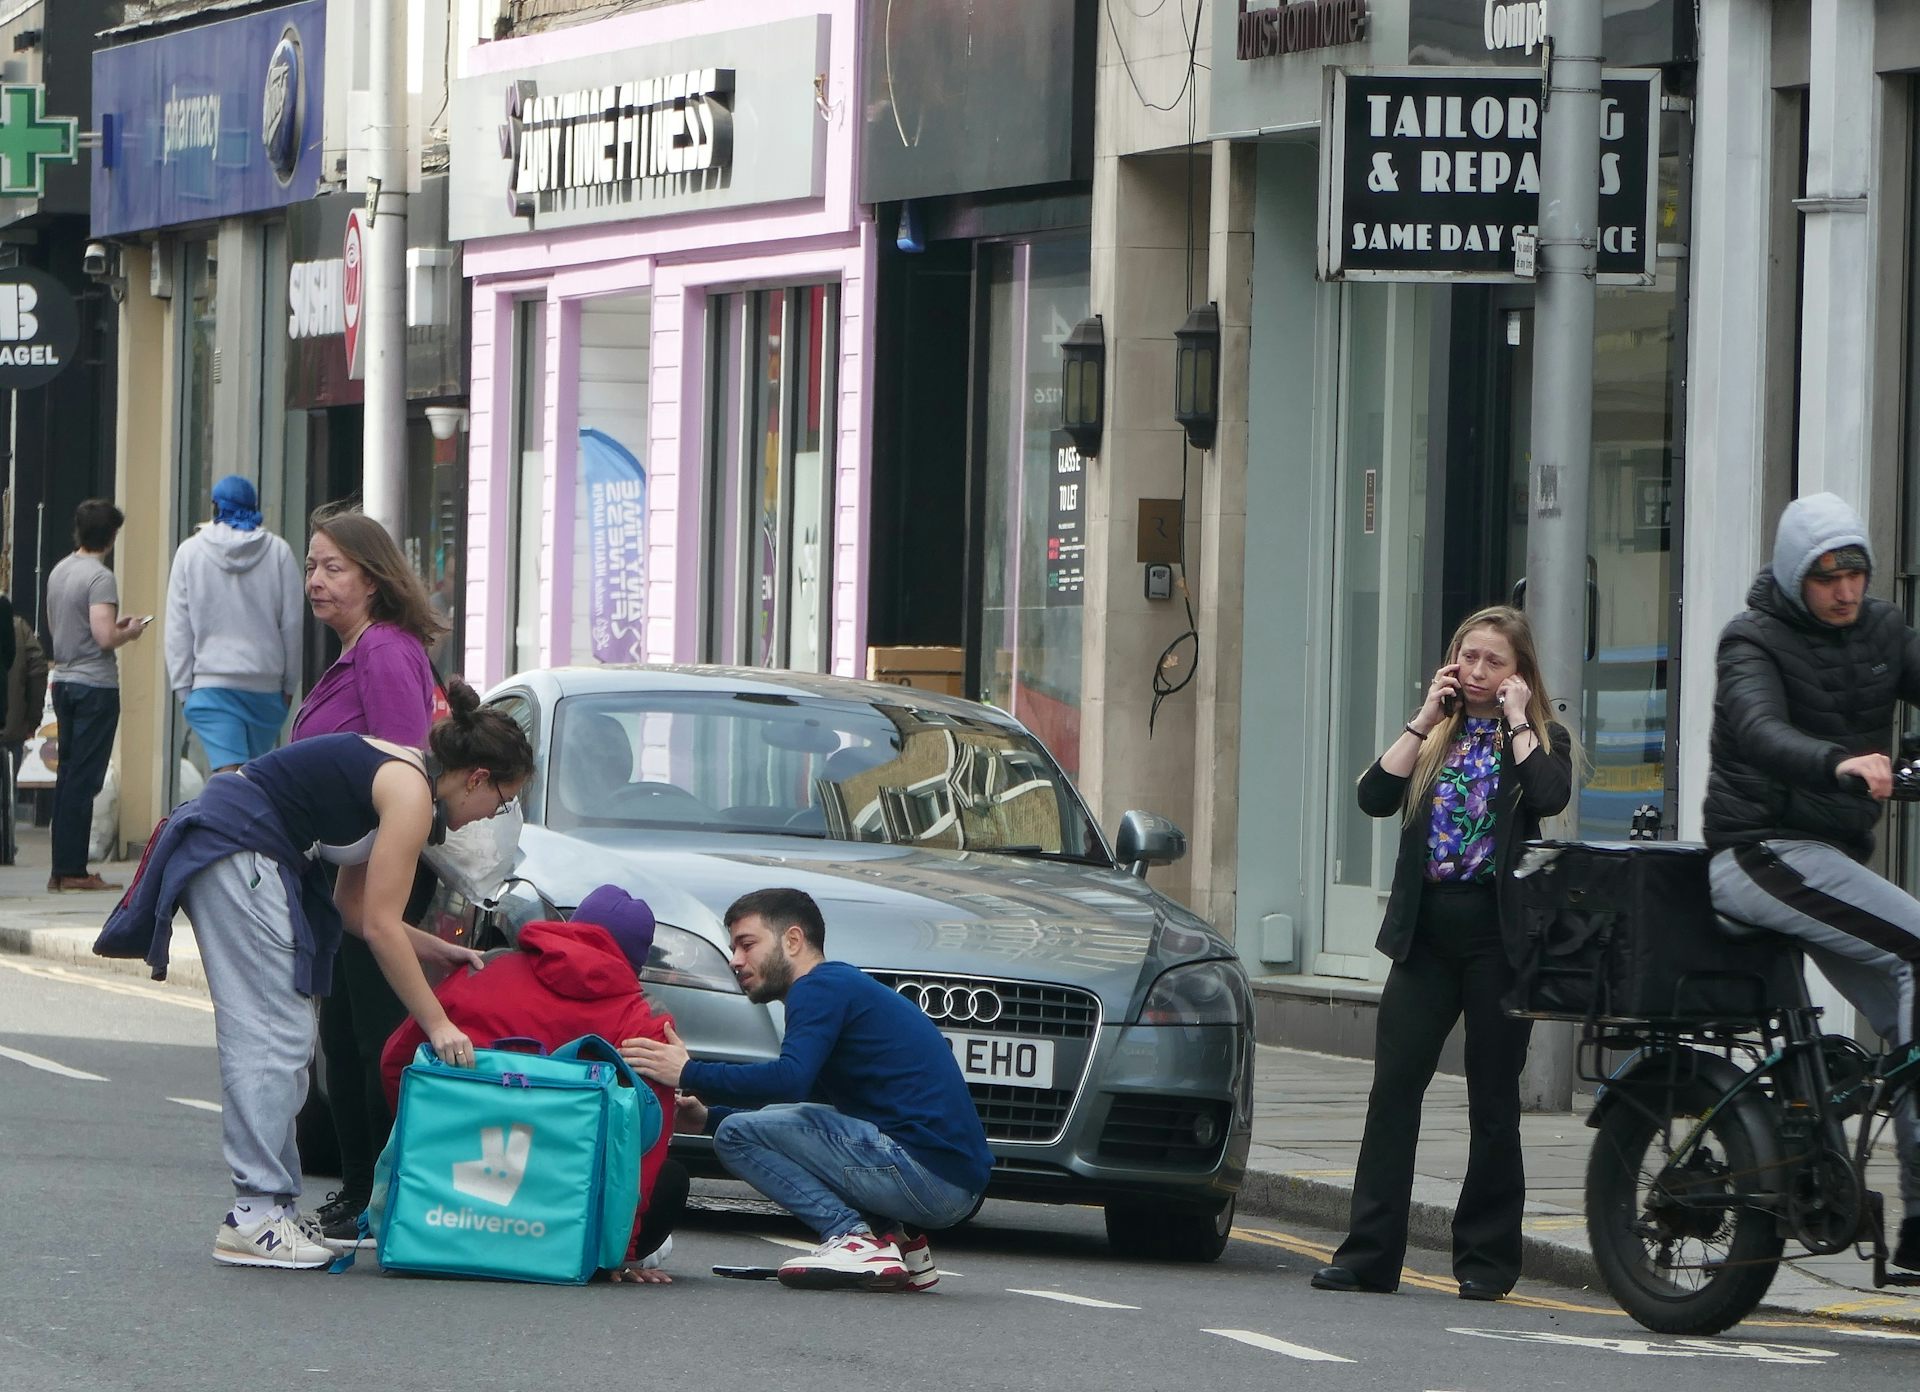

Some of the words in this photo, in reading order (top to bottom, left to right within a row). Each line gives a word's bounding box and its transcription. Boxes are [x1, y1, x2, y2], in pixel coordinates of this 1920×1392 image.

[1484, 0, 1546, 55] Compa
[164, 83, 221, 166] pharmacy
[517, 86, 615, 194] ANYTIME
[617, 67, 718, 180] FITNESS
[1367, 95, 1624, 140] TAILORG
[1367, 152, 1399, 192] &
[1420, 150, 1621, 195] REPAS
[1352, 223, 1432, 250] SAME
[1440, 224, 1504, 251] DAY
[289, 254, 344, 340] SUSHI
[0, 345, 60, 366] AGEL
[425, 1203, 546, 1238] deliveroo
